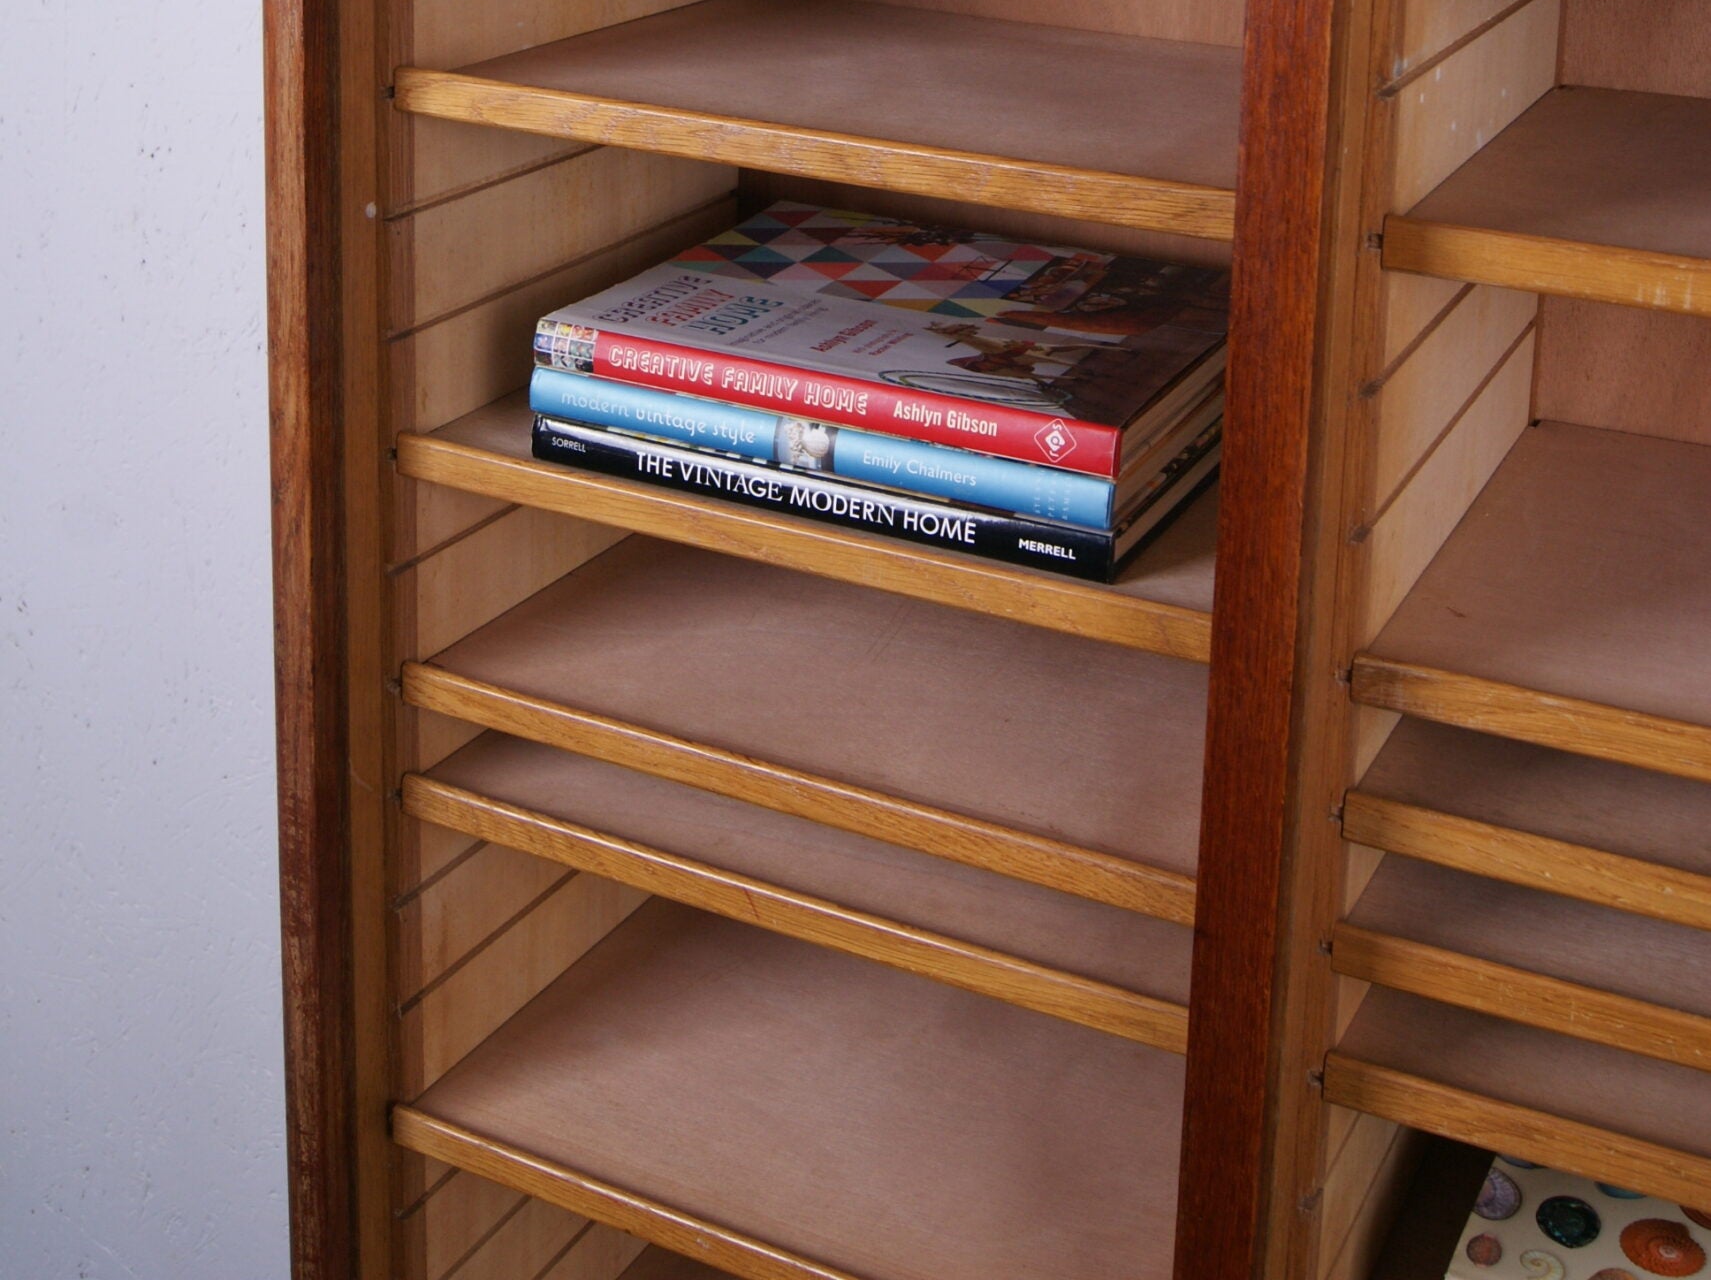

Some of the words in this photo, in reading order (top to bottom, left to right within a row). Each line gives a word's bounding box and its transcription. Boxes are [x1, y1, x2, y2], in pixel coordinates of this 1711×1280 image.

[592, 274, 713, 324] CREATIVE
[646, 287, 735, 327] FAMILY
[683, 296, 784, 335] HOME
[608, 344, 714, 386] CREATIVE
[721, 367, 798, 401] FAMILY
[804, 382, 868, 416] HOME
[561, 391, 628, 418] modern
[635, 407, 705, 436] vintage
[712, 421, 757, 446] style
[893, 400, 942, 427] Ashlyn
[947, 410, 998, 437] Gibson
[552, 436, 586, 453] SORRELL
[863, 452, 900, 474] Emily
[906, 459, 977, 487] Chalmers
[636, 451, 673, 478] THE
[680, 460, 783, 502] VINTAGE
[789, 487, 896, 526] MODERN
[903, 510, 977, 544] HOME
[1018, 538, 1076, 560] MERRELL
